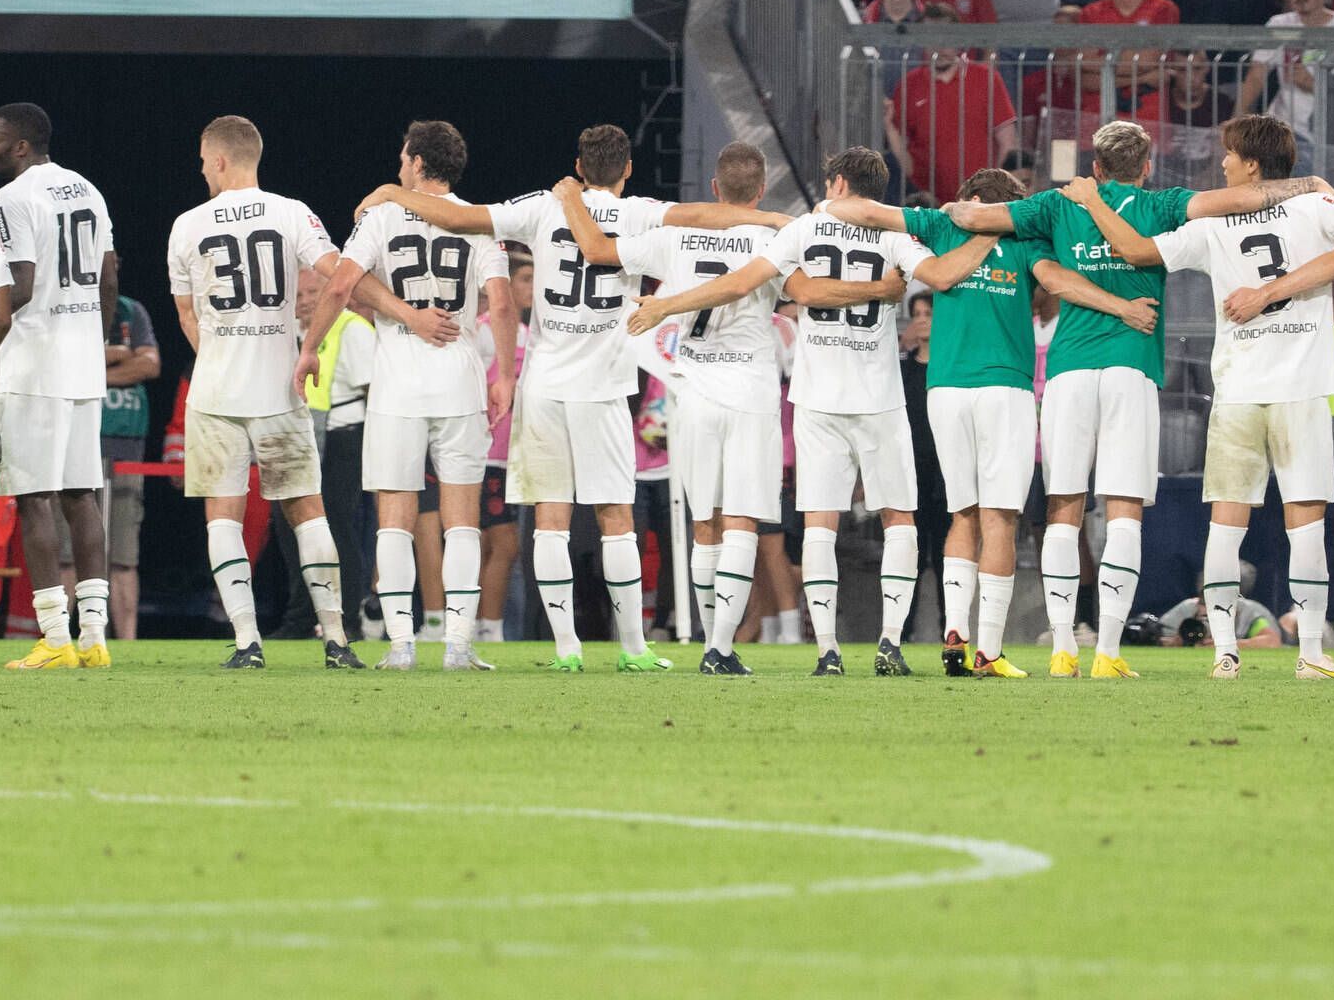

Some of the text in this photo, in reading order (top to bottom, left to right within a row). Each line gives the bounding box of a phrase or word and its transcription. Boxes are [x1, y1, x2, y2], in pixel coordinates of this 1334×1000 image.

[56, 208, 99, 288] 10
[214, 202, 266, 224] ELVEDI
[680, 234, 753, 254] HERRMANN
[814, 221, 883, 245] HOFMANN
[198, 229, 287, 311] 30
[388, 234, 472, 312] 29
[689, 260, 730, 340] 7
[1077, 262, 1099, 272] Invest
[1240, 233, 1294, 316] 3
